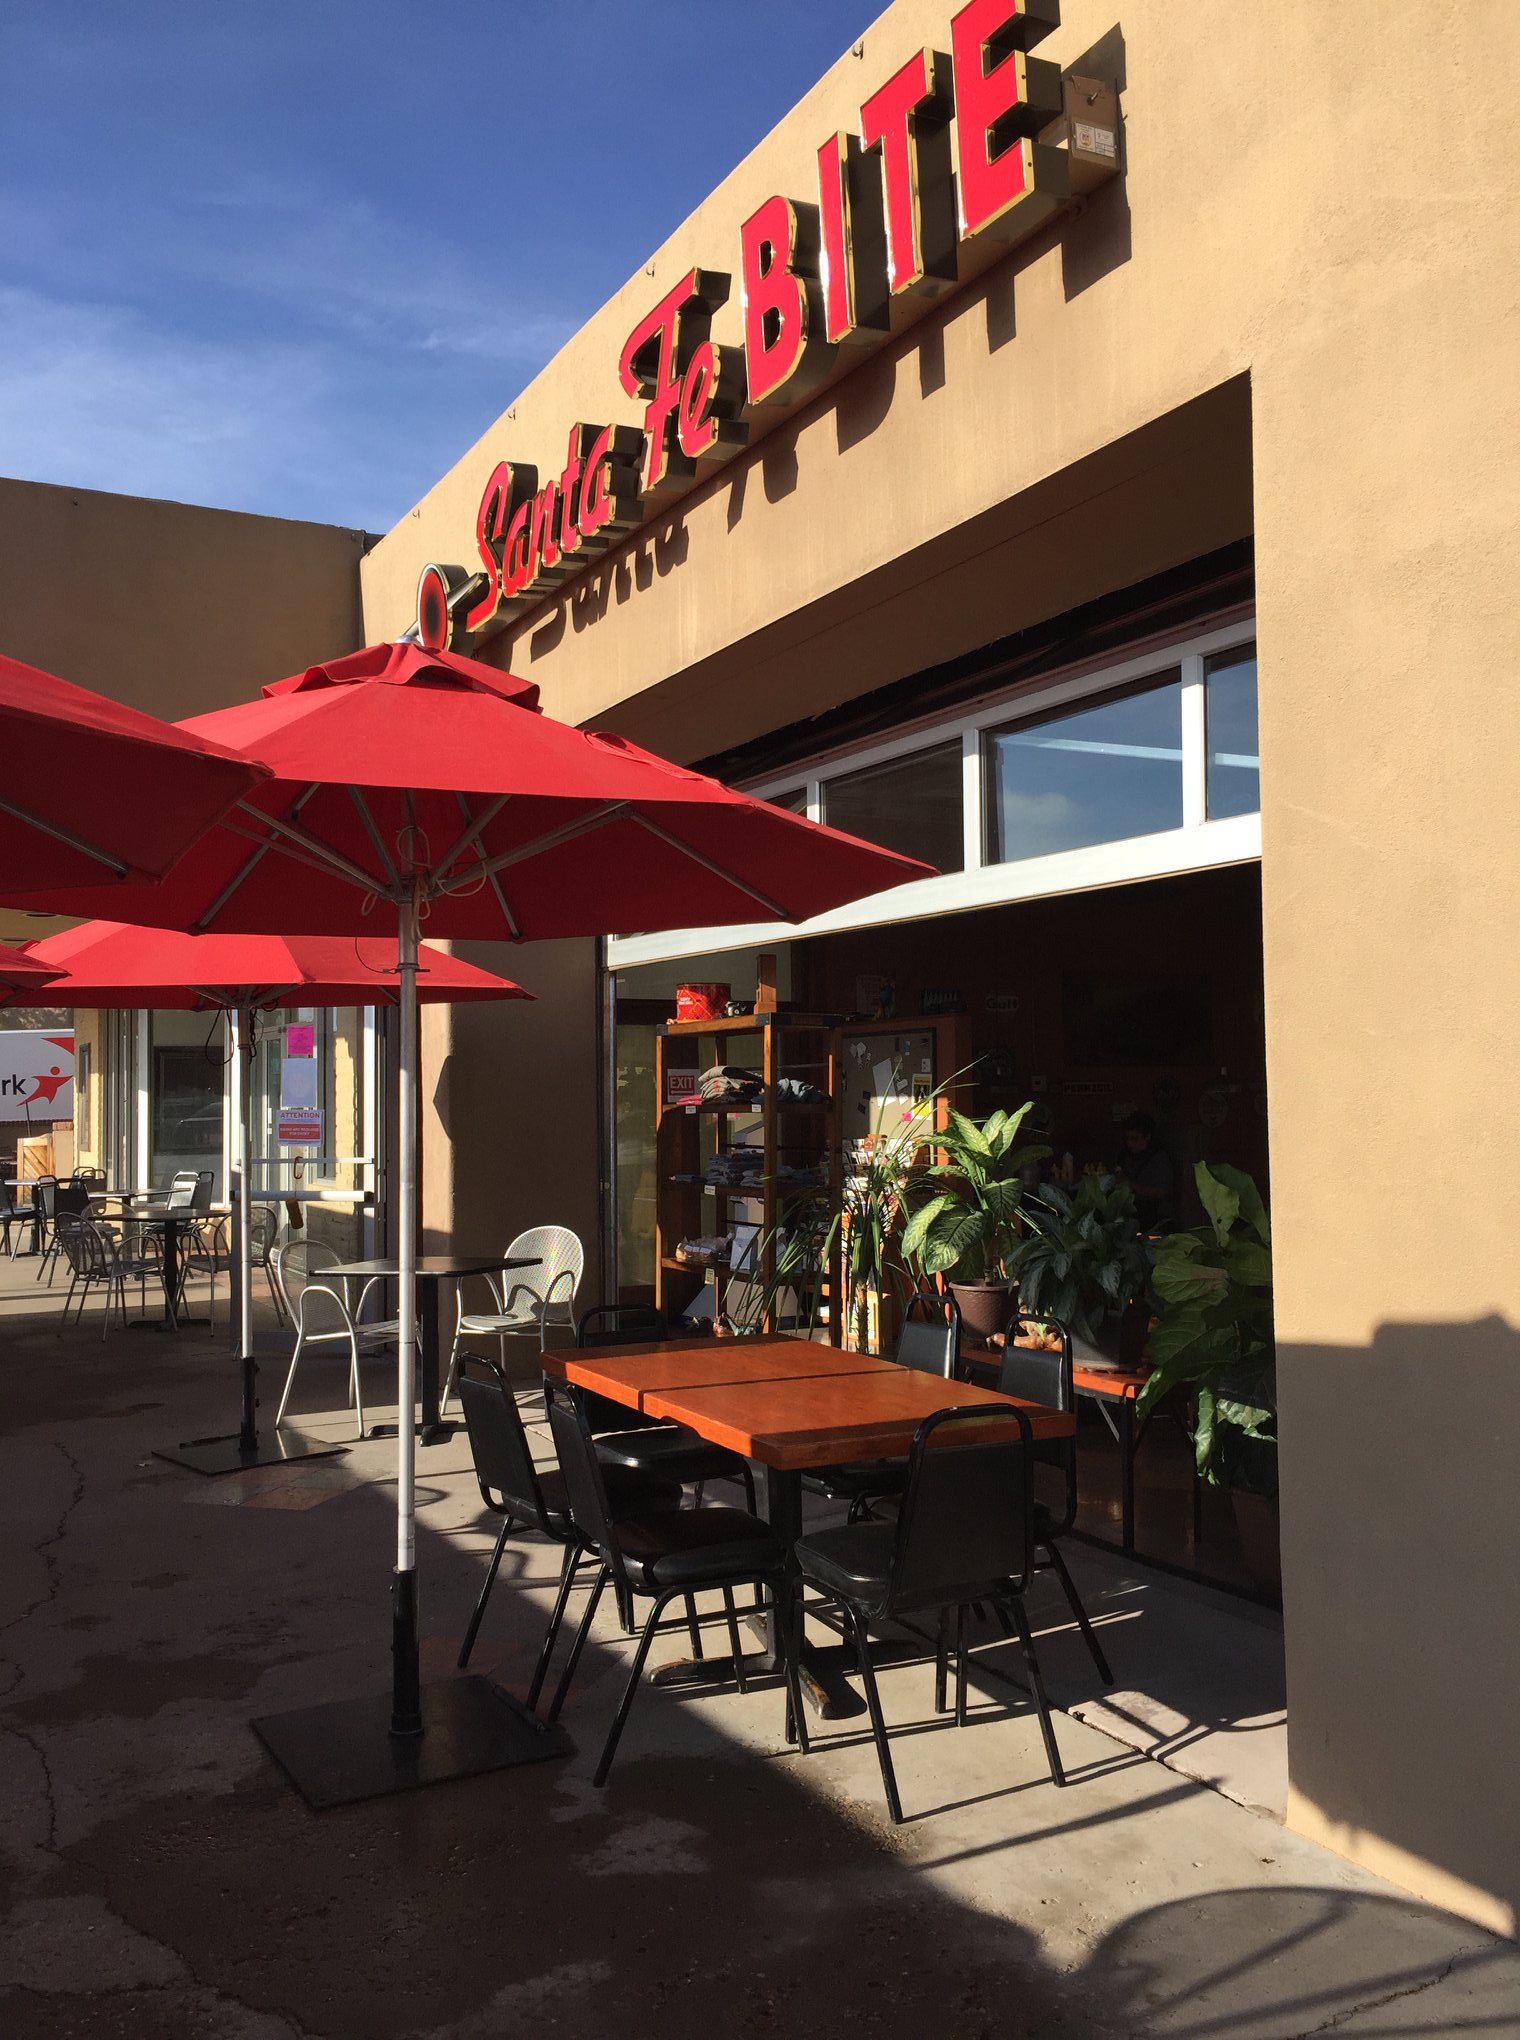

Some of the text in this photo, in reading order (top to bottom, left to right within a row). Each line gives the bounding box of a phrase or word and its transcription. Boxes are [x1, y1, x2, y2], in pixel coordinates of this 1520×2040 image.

[466, 0, 1036, 632] Santa Fe BITE
[670, 1076, 694, 1089] EXIT
